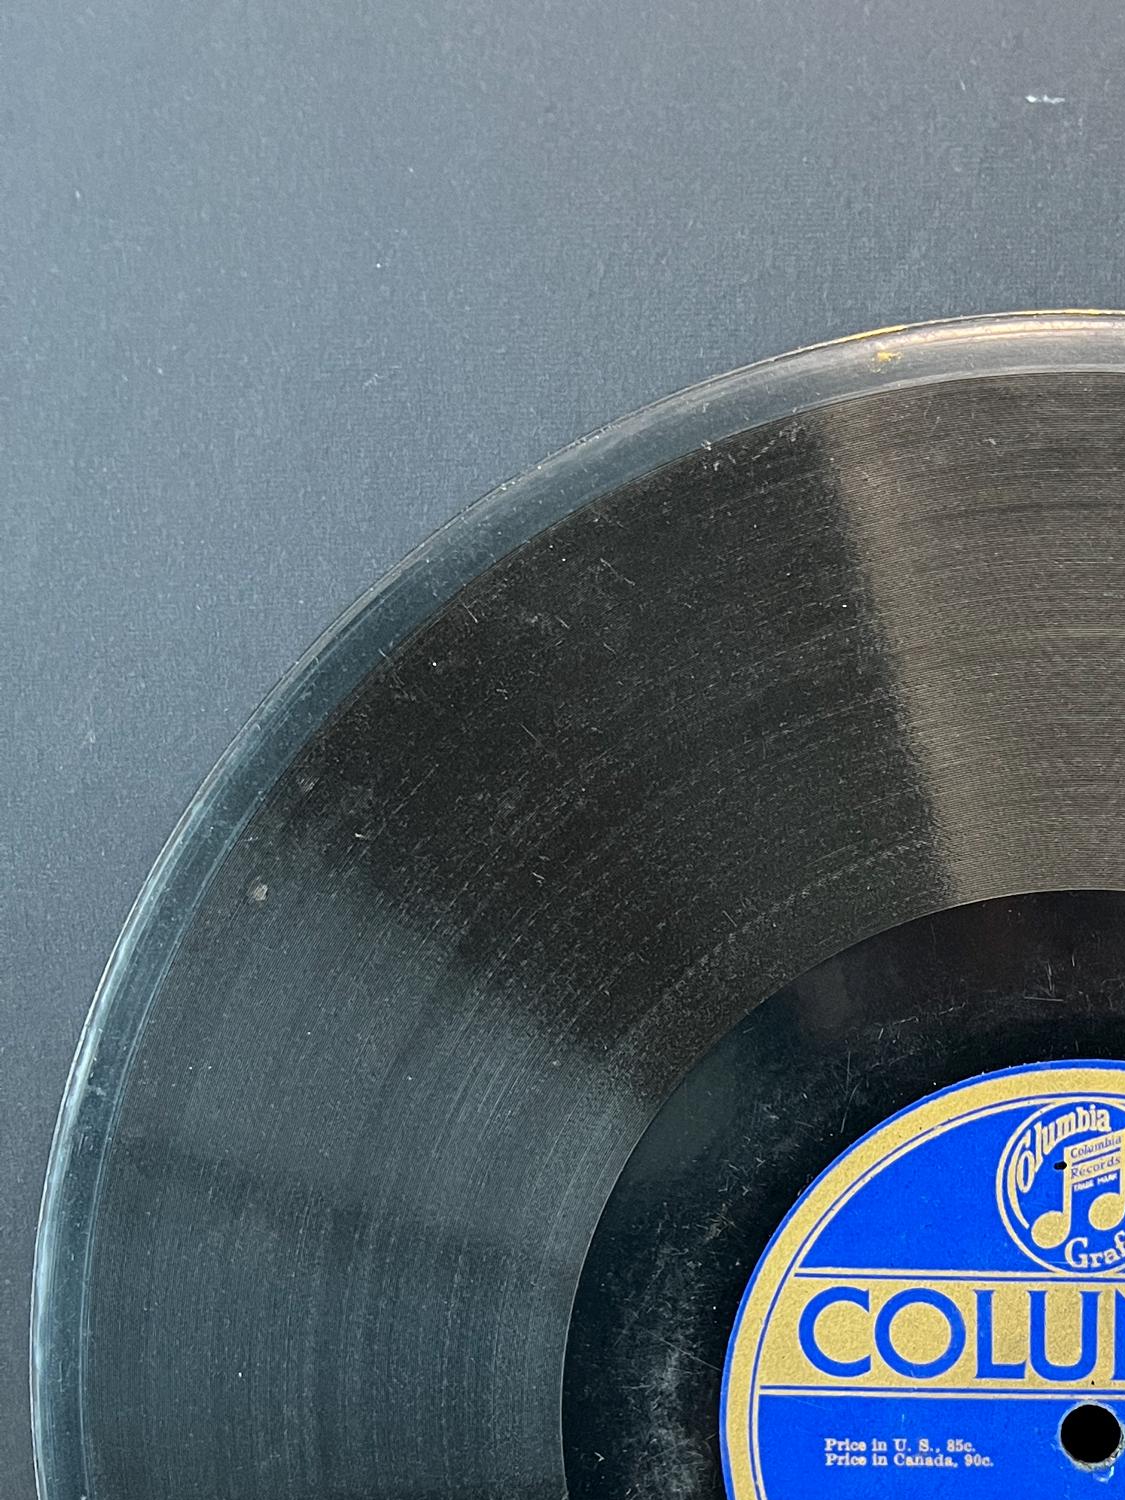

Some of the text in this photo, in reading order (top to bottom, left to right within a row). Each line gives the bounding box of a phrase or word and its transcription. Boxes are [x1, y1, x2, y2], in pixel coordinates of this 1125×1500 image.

[1071, 1136, 1122, 1158] Columbia
[1007, 1105, 1111, 1229] Columbia
[1071, 1156, 1121, 1180] Records
[824, 1438, 866, 1452] Price
[872, 1438, 887, 1452] in
[946, 1439, 976, 1453] 85c.
[825, 1453, 994, 1468] Price in Canada, 90c.
